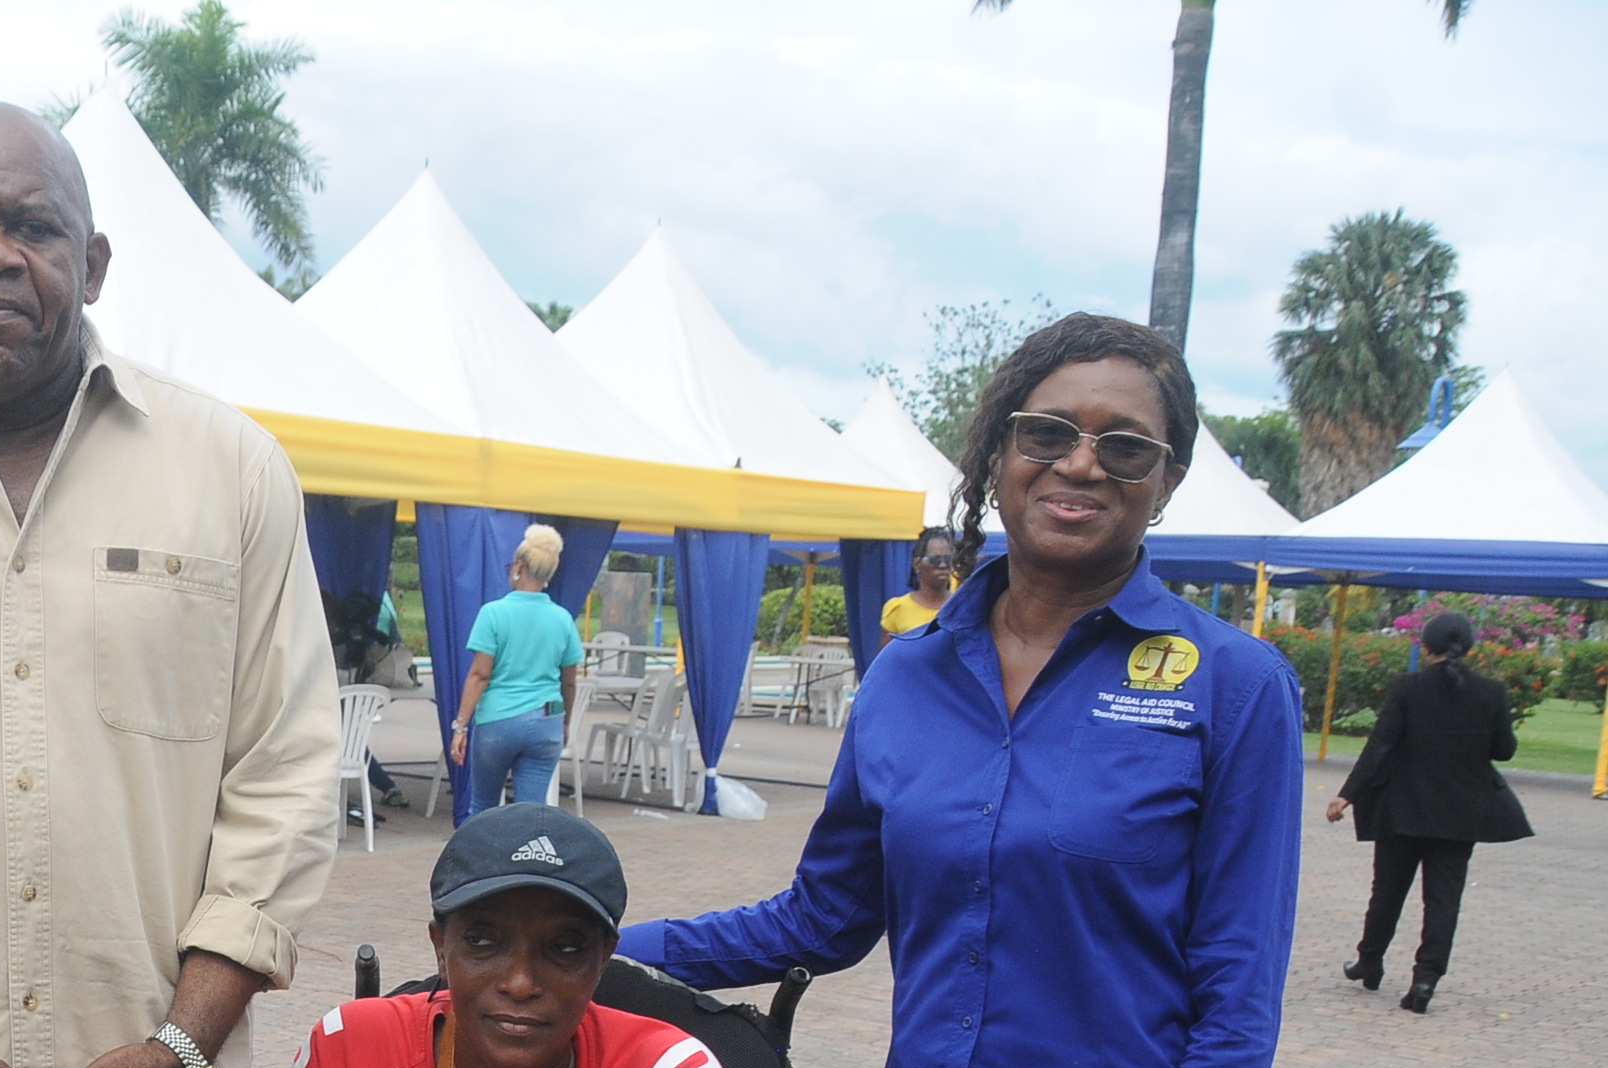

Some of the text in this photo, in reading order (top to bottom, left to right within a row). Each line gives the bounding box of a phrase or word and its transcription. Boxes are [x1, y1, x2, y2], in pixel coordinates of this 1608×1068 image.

[1110, 704, 1139, 713] MINISTRY
[1149, 708, 1175, 716] JUSTICE
[1115, 695, 1140, 706] LEGAL
[1141, 698, 1157, 706] AID
[1158, 699, 1195, 711] COUNCIL
[511, 850, 564, 867] adidas
